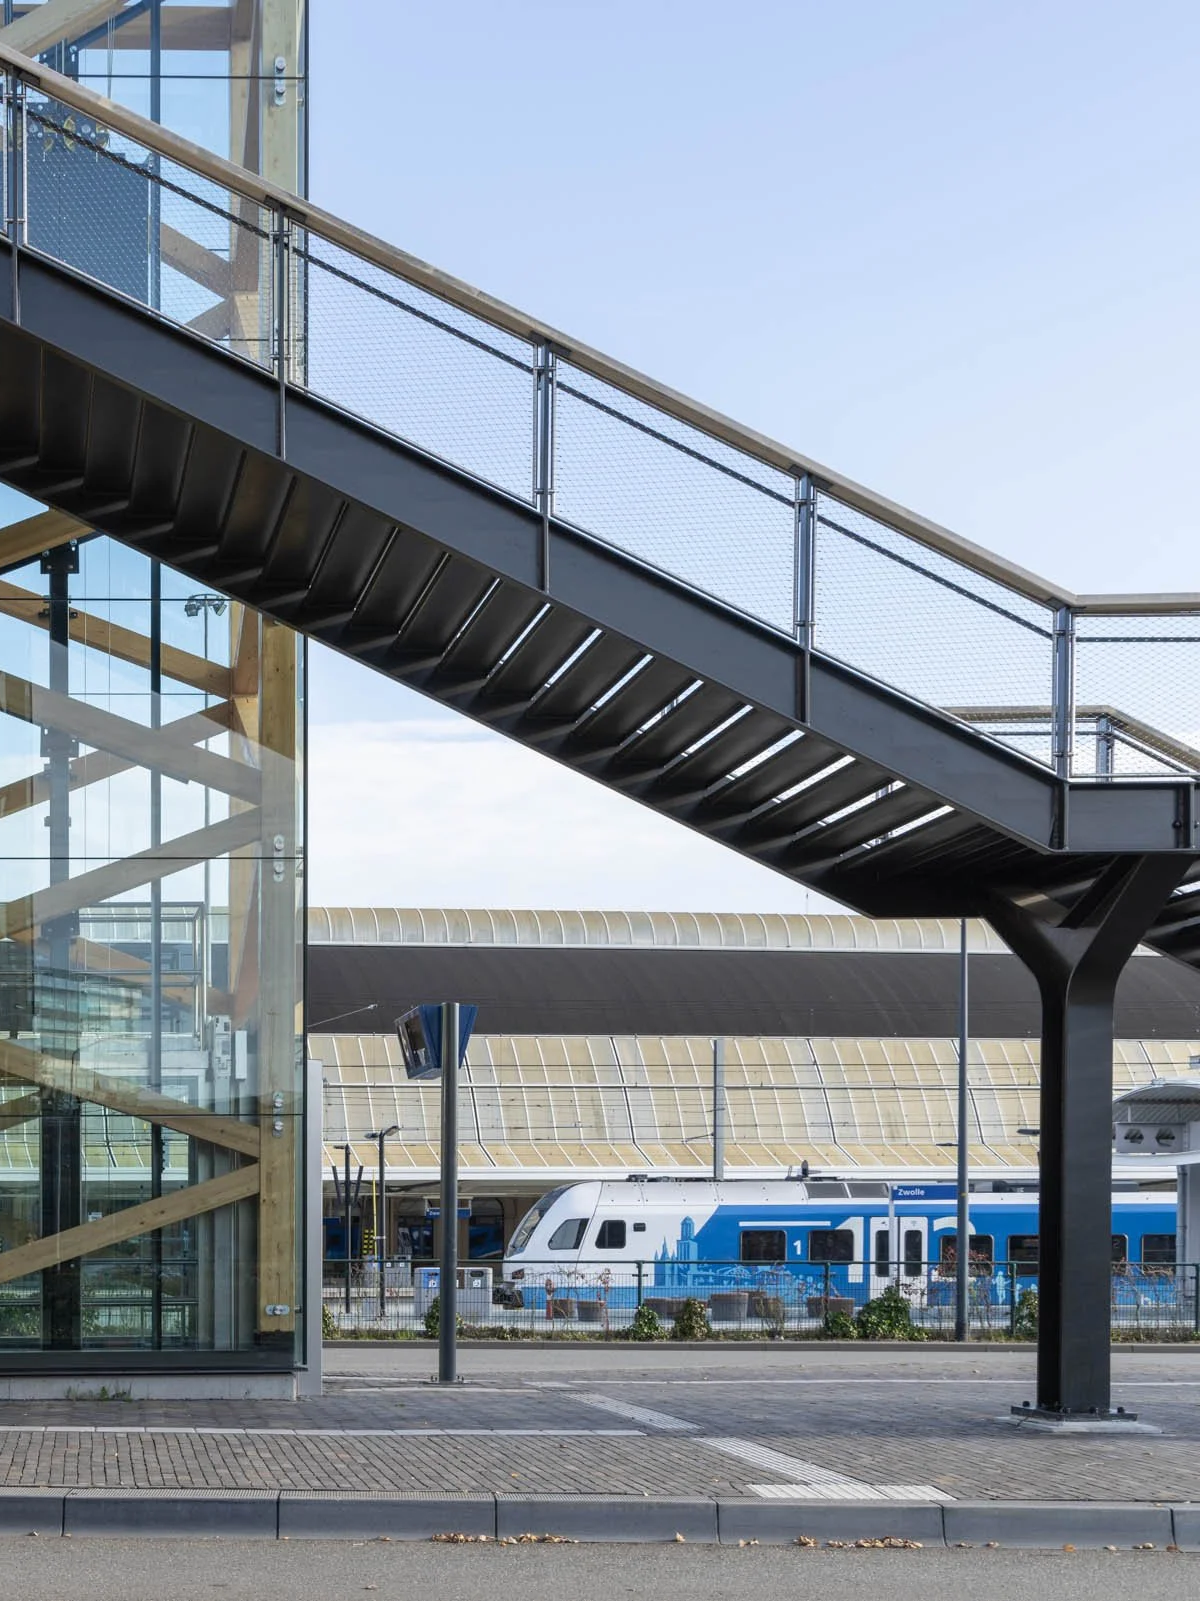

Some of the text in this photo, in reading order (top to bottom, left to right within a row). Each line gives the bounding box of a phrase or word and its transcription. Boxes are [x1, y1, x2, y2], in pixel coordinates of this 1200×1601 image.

[898, 1188, 925, 1196] Zwolle
[793, 1240, 802, 1255] 1
[835, 1216, 865, 1283] 1
